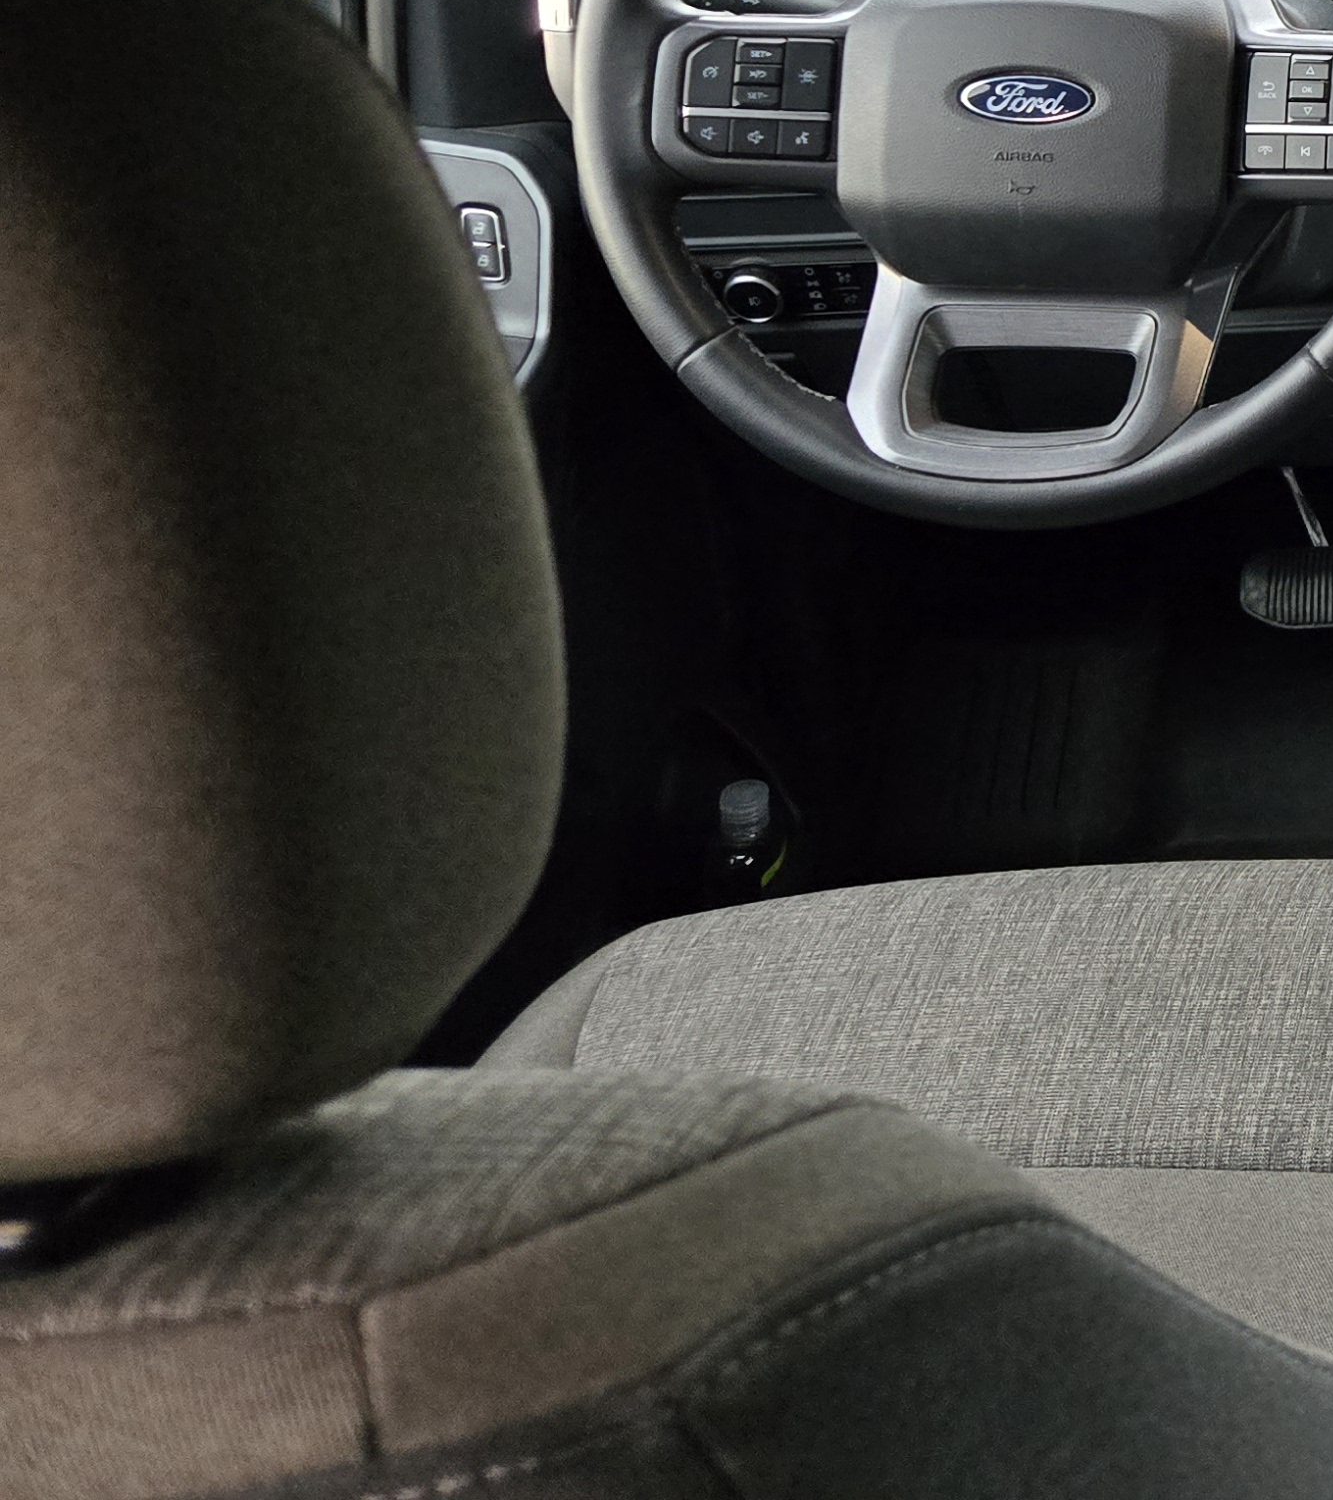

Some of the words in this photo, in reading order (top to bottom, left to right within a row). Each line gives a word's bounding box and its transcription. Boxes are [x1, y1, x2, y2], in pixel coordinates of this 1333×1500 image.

[1257, 91, 1277, 99] BACK
[1301, 86, 1313, 94] OK
[986, 81, 1067, 114] Ford
[993, 151, 1054, 163] AIRBAG
